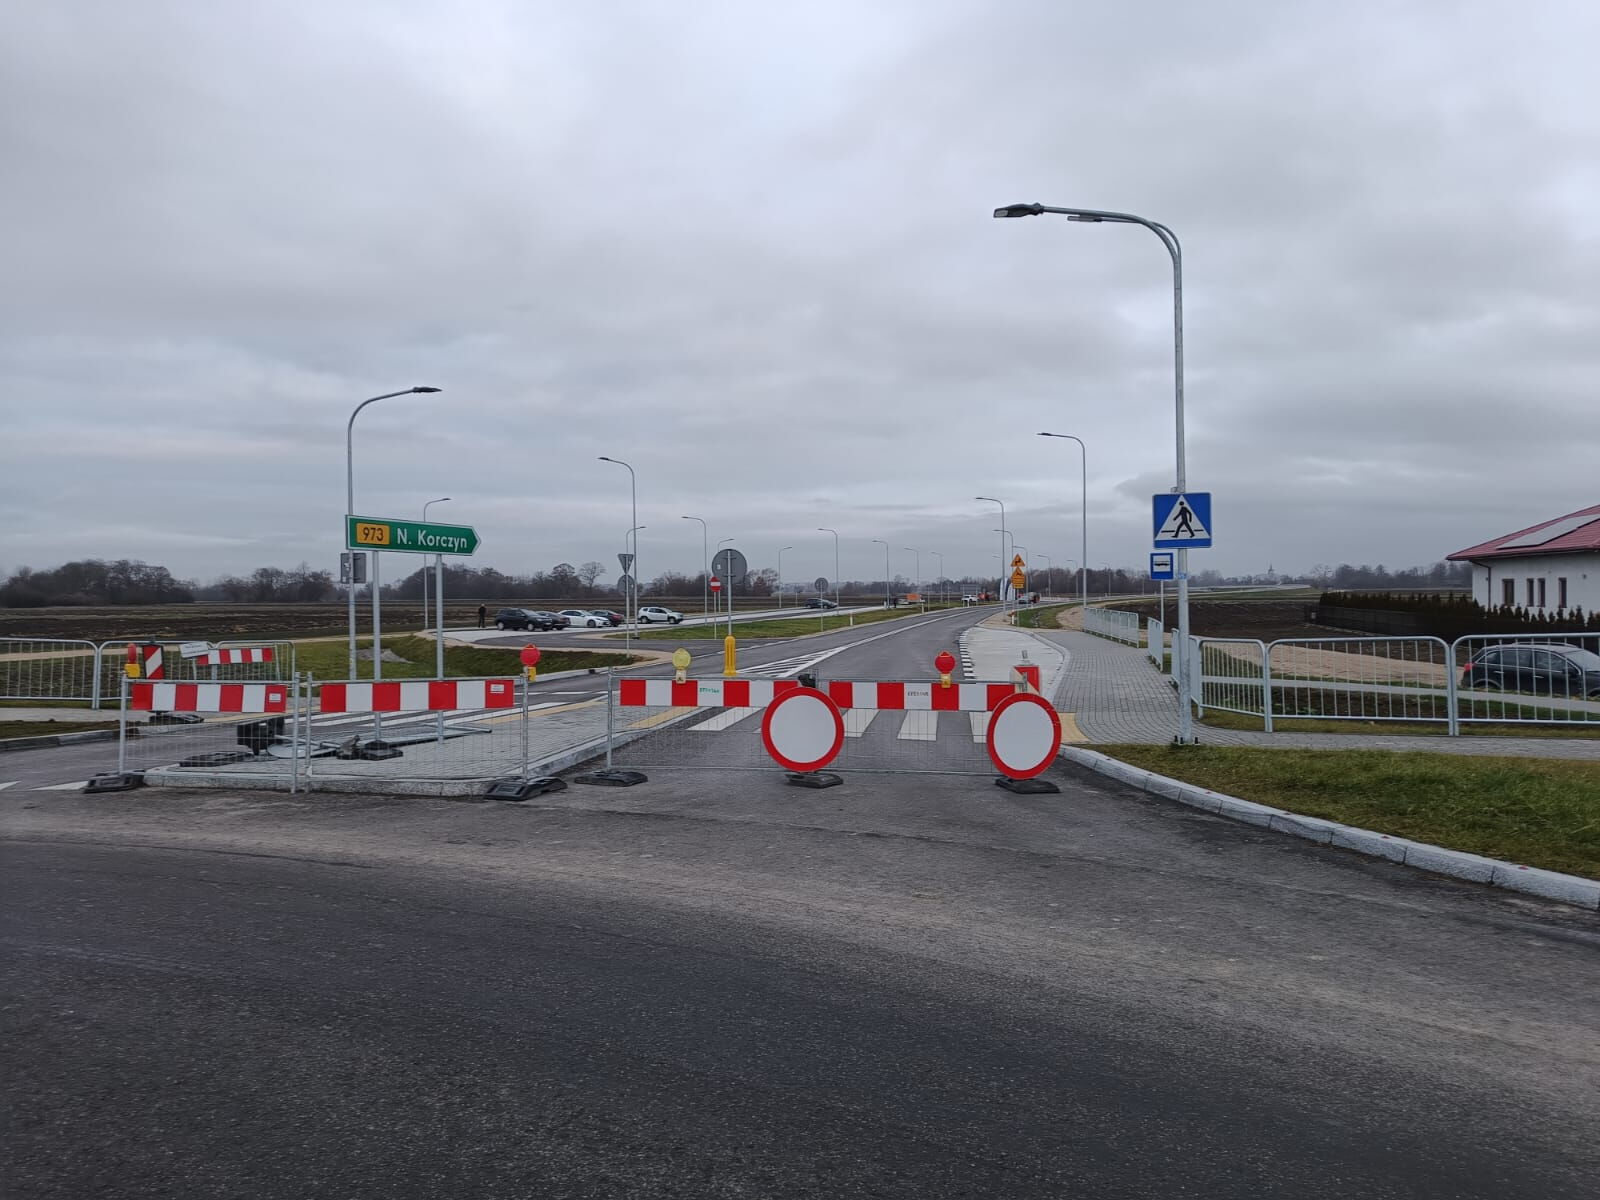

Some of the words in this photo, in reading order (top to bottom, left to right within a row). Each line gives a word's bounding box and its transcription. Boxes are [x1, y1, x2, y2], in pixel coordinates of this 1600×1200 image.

[362, 527, 384, 541] 973
[397, 528, 412, 545] N.
[418, 530, 467, 552] Korczyn
